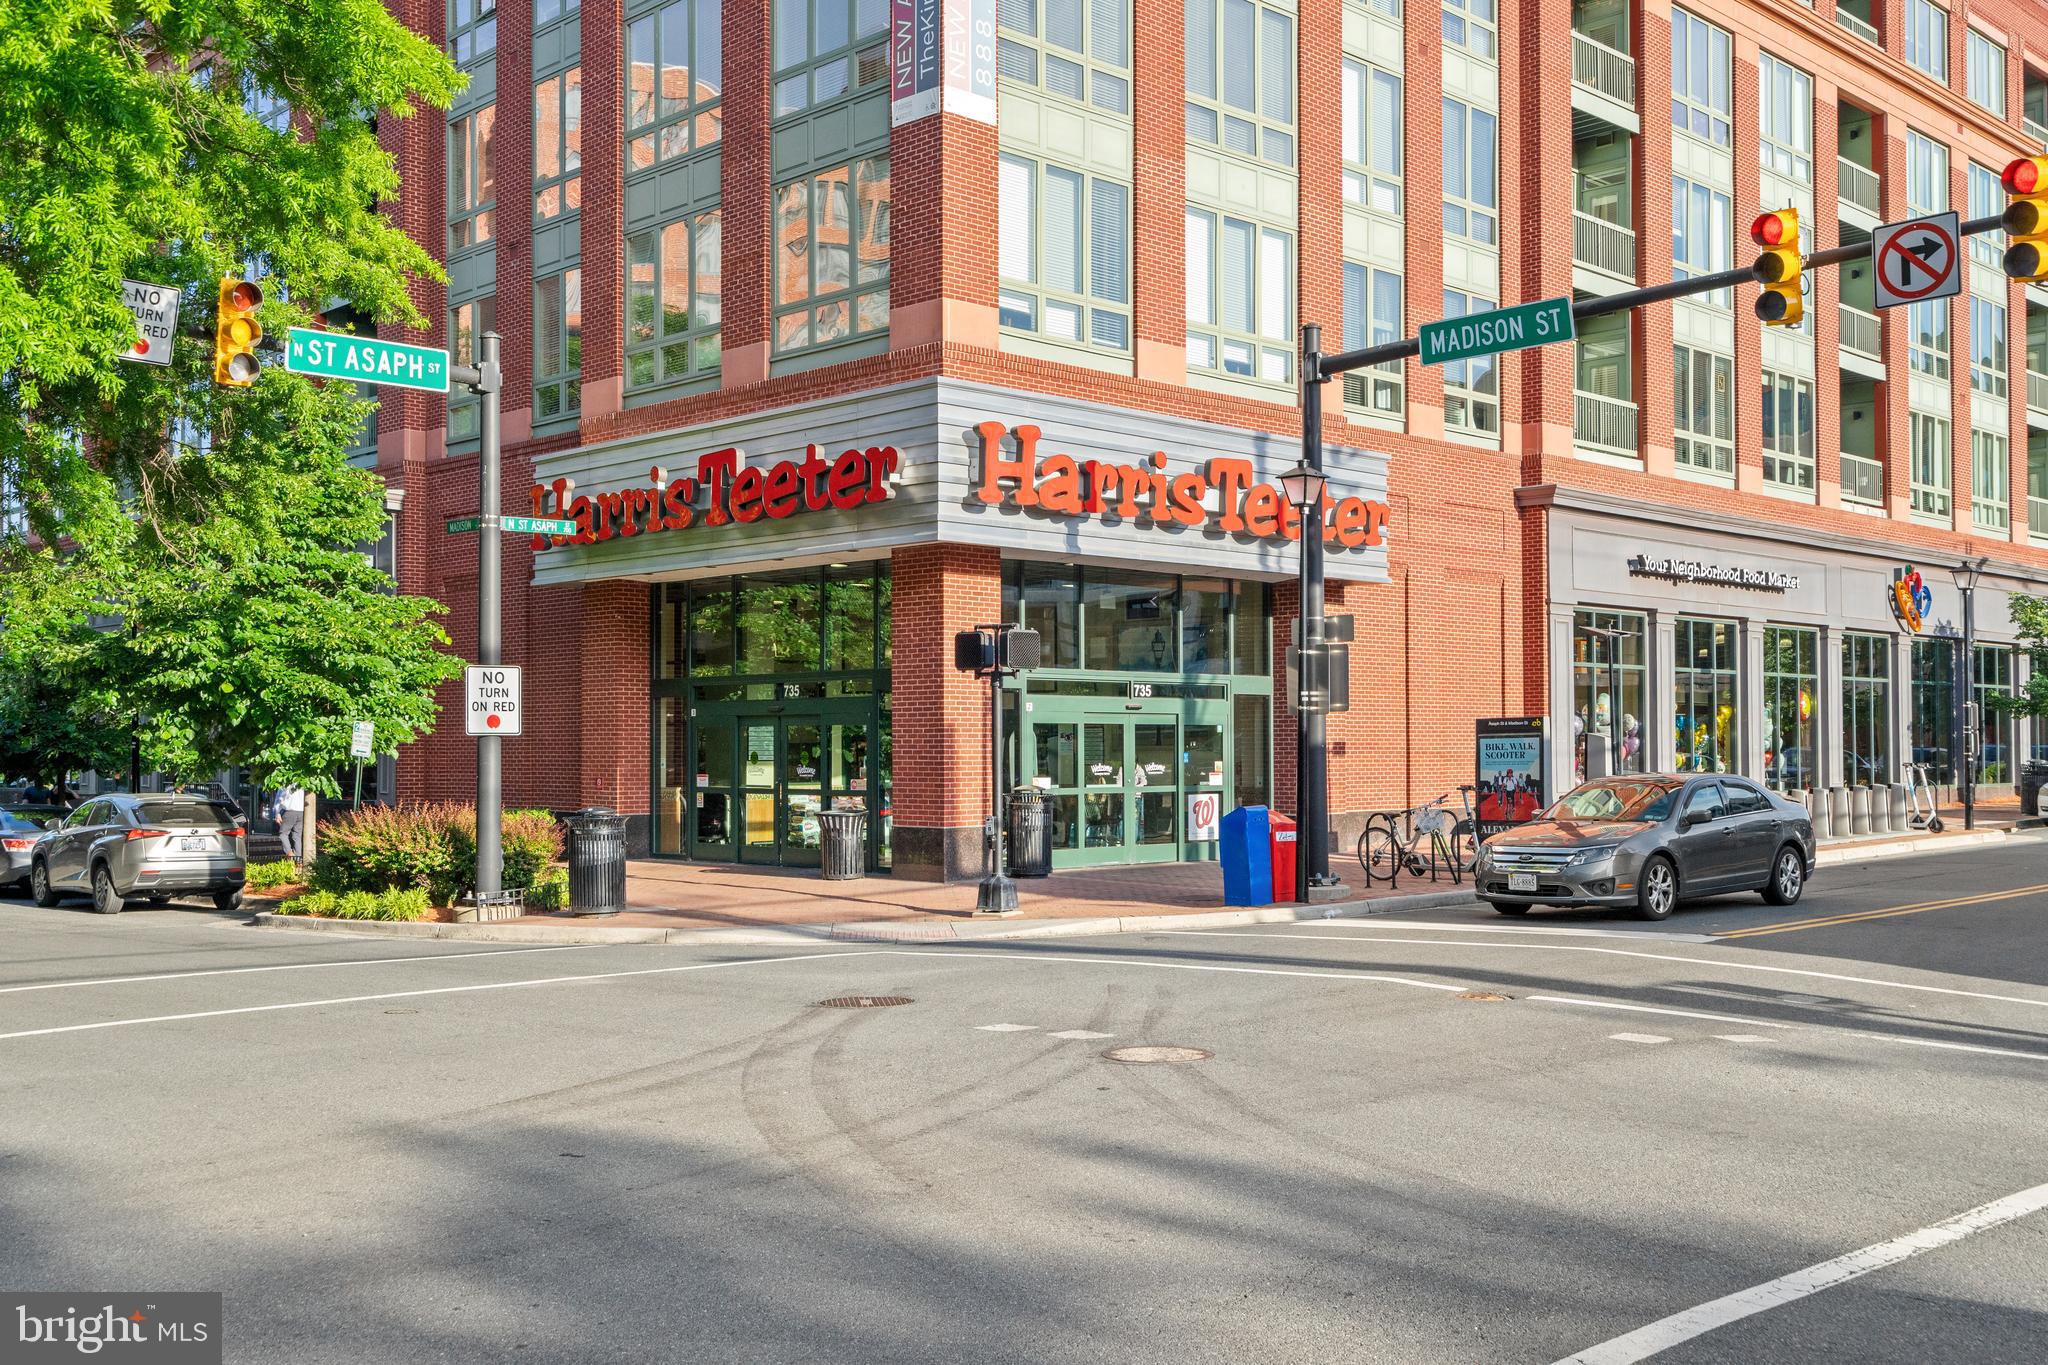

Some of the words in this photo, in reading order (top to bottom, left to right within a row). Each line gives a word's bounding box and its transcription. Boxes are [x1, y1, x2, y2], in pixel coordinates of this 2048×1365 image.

[949, 6, 967, 80] NEW
[897, 20, 912, 89] NEW
[134, 288, 160, 305] NO
[143, 324, 169, 339] RED
[1430, 315, 1524, 355] MADISON
[1535, 308, 1560, 336] ST
[293, 343, 303, 357] N
[307, 339, 336, 367] ST
[344, 345, 423, 379] ASAPH
[428, 362, 440, 374] ST
[977, 421, 1206, 525] Harris
[529, 465, 697, 552] Harris
[697, 443, 903, 527] Teeter
[508, 520, 514, 529] N
[518, 521, 528, 530] ST
[531, 521, 557, 532] ASAPH
[1643, 554, 1669, 573] Your
[1671, 559, 1741, 582] Neighborhood
[1743, 568, 1766, 585] Food
[1768, 572, 1800, 589] Market
[482, 671, 505, 684] NO
[479, 687, 509, 698] TURN
[783, 684, 800, 697] 735
[1133, 684, 1151, 697] 735
[472, 701, 487, 712] ON
[493, 701, 515, 712] RED
[1485, 743, 1508, 751] BIKE,
[1509, 742, 1536, 751] WALK,
[1485, 751, 1526, 760] SCOOTER
[1480, 825, 1514, 834] ALEX
